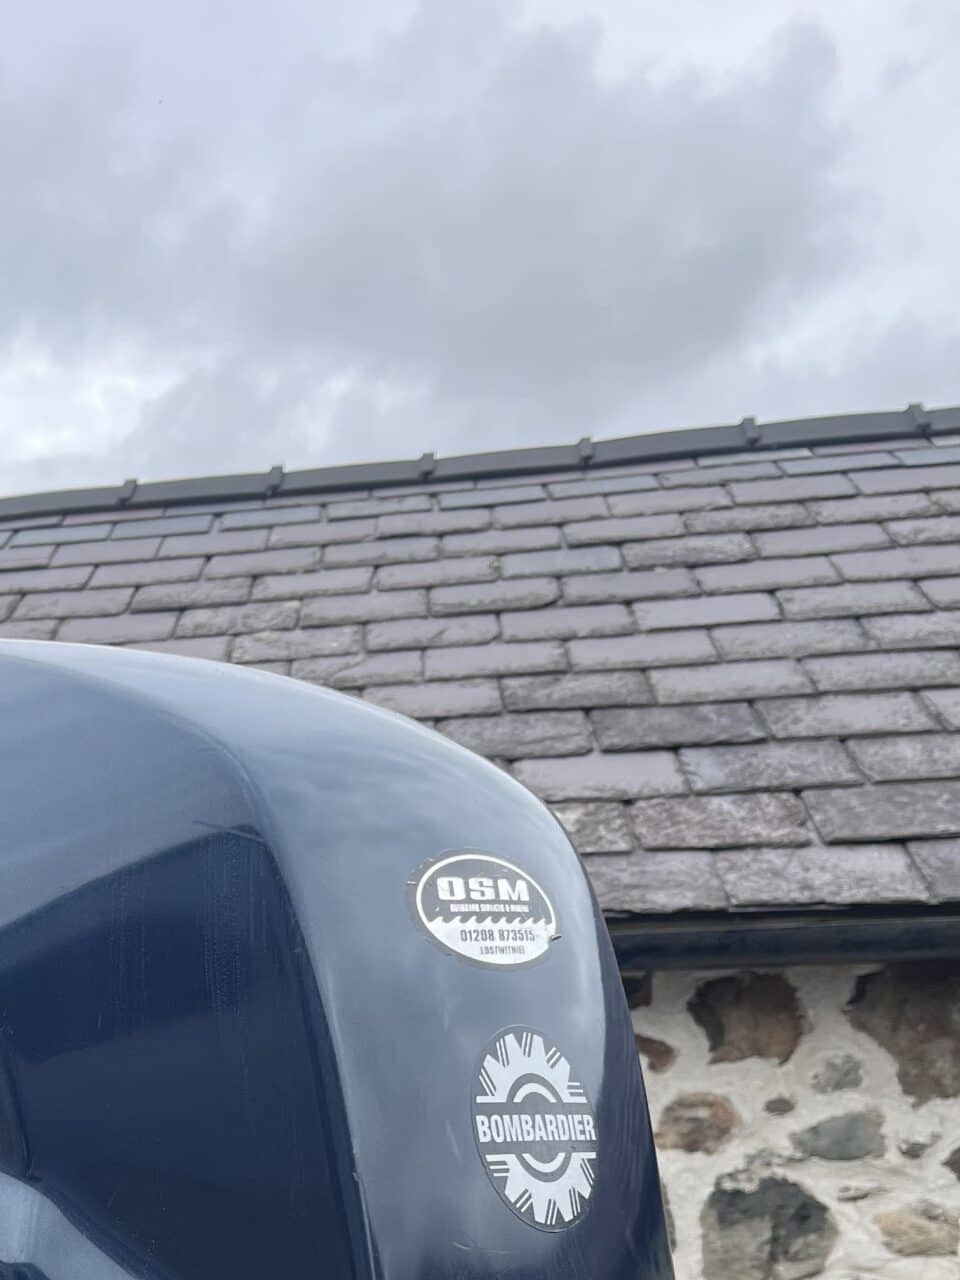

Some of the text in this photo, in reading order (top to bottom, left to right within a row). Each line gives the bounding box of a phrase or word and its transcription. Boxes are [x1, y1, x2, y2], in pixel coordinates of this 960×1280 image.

[437, 877, 530, 901] OSM
[460, 929, 495, 942] 01208
[476, 1114, 597, 1142] BOMBARDIER
